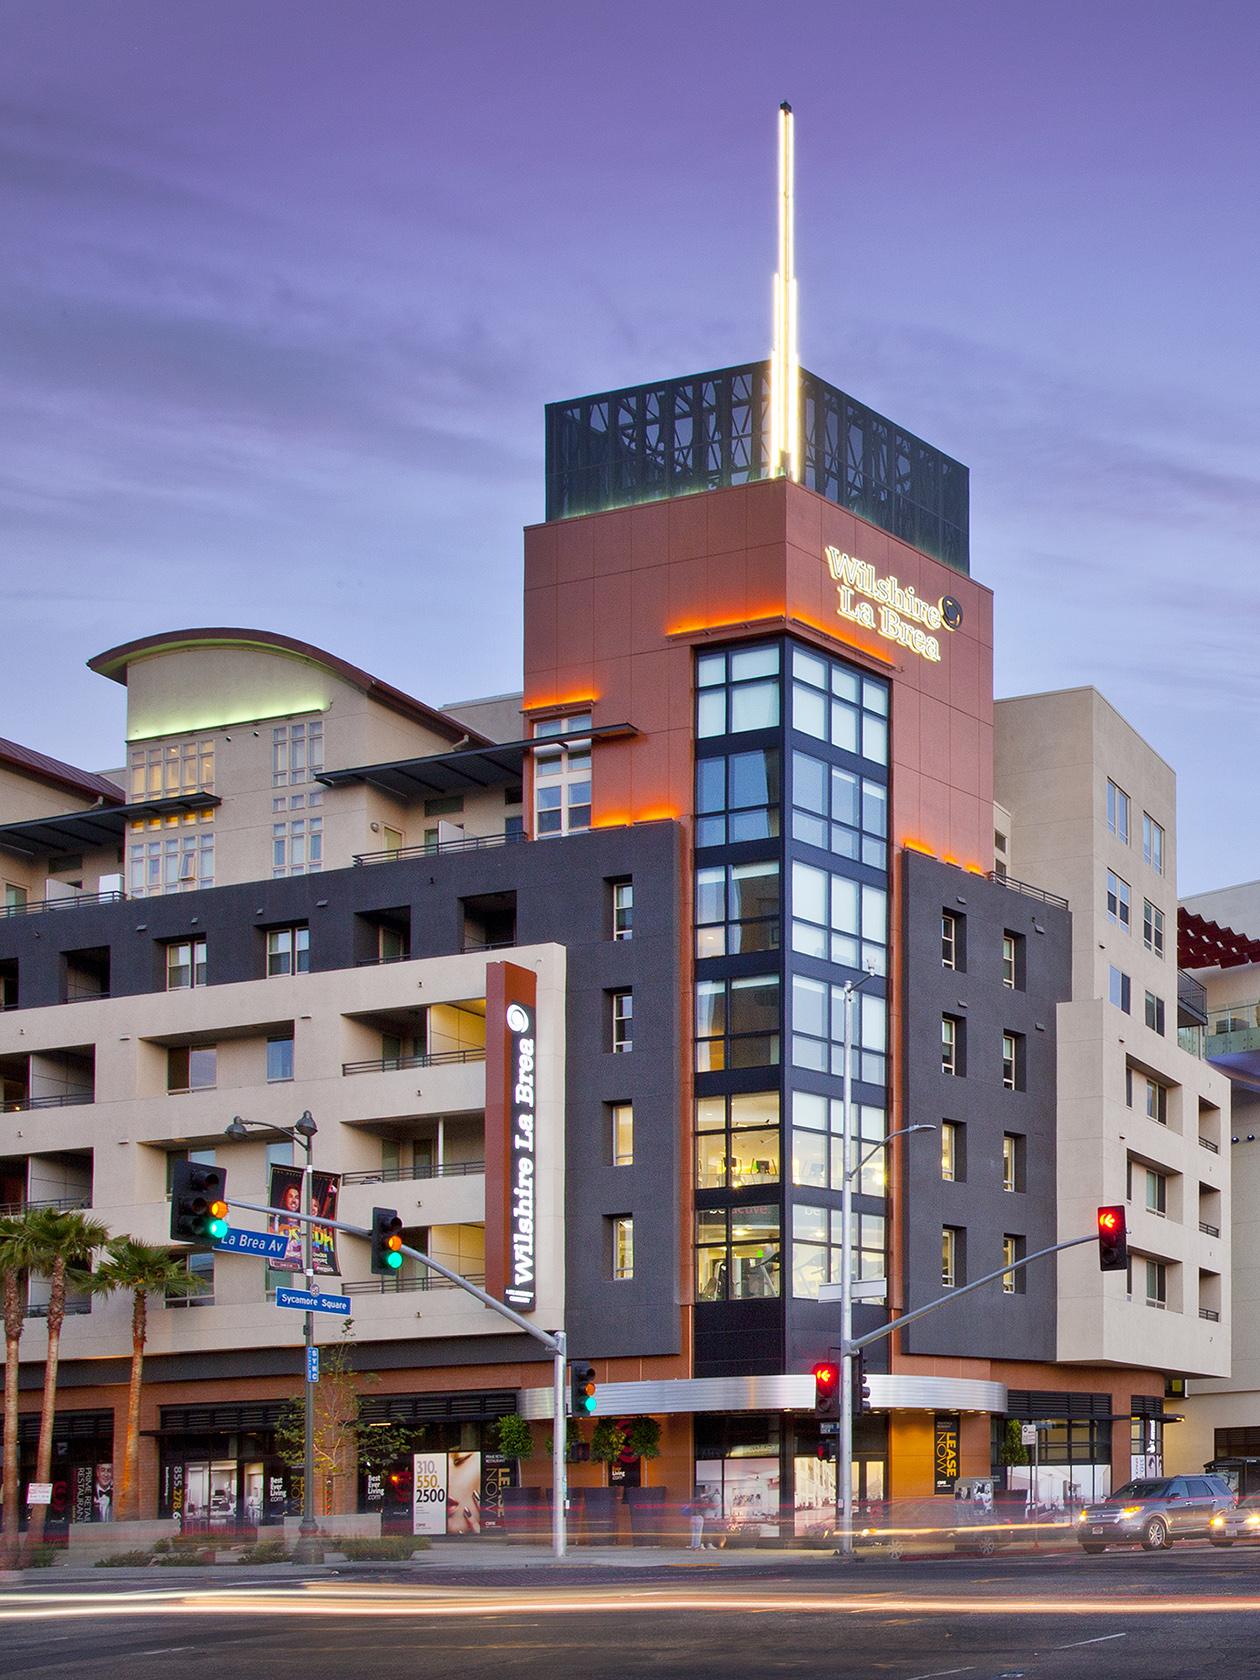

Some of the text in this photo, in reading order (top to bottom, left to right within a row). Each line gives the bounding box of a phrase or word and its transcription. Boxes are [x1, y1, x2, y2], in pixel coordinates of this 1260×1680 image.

[825, 546, 942, 630] Wilshire
[837, 585, 941, 663] La Brea
[515, 1038, 534, 1107] Brea
[515, 1114, 534, 1152] La
[221, 1233, 284, 1252] La Brea Av
[514, 1157, 534, 1286] Wilshire
[281, 1293, 347, 1310] Sycamore Square
[417, 1460, 437, 1474] 310.
[937, 1432, 947, 1474] NOW
[946, 1432, 956, 1477] LEASE
[416, 1488, 445, 1503] 2500
[417, 1474, 440, 1488] 550.
[485, 1468, 497, 1514] NOW
